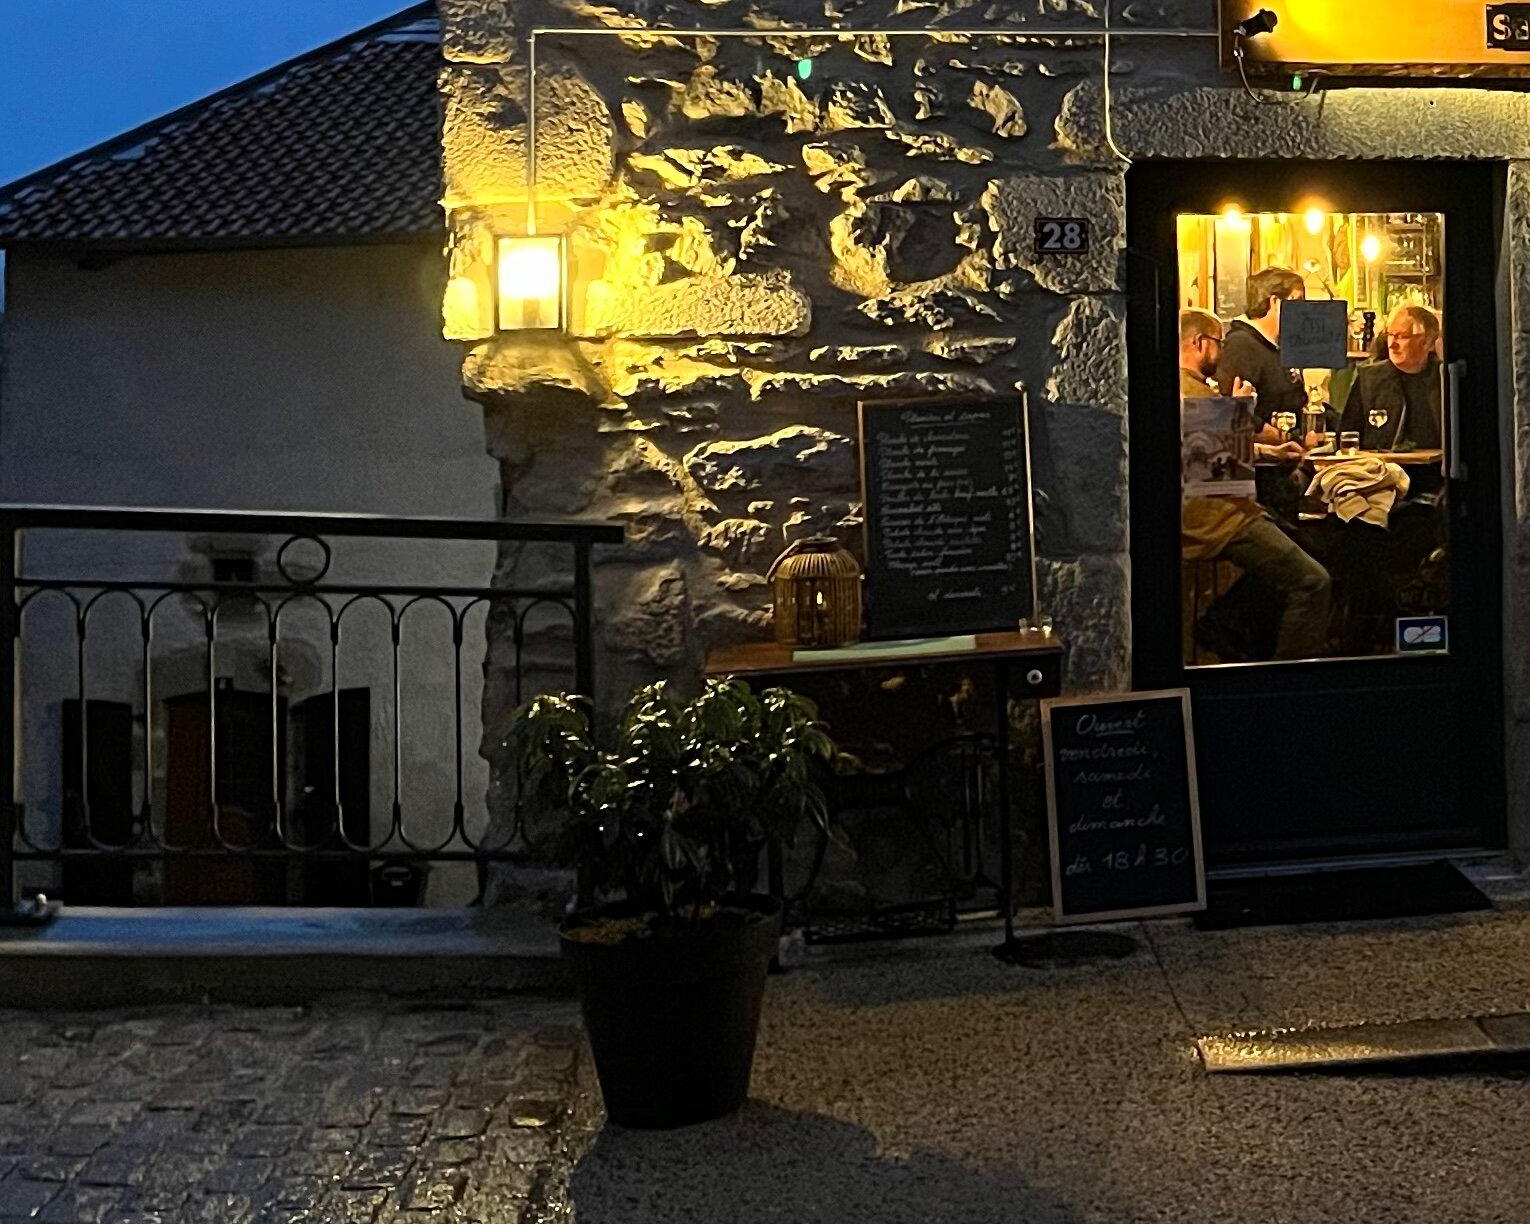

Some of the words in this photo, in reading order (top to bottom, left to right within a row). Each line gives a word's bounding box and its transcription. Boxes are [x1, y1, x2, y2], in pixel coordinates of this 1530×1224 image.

[1042, 222, 1081, 249] 28
[1076, 709, 1146, 735] Ouvert
[1072, 763, 1151, 785] samedi
[1102, 789, 1123, 809] et
[1068, 803, 1167, 834] dimanche
